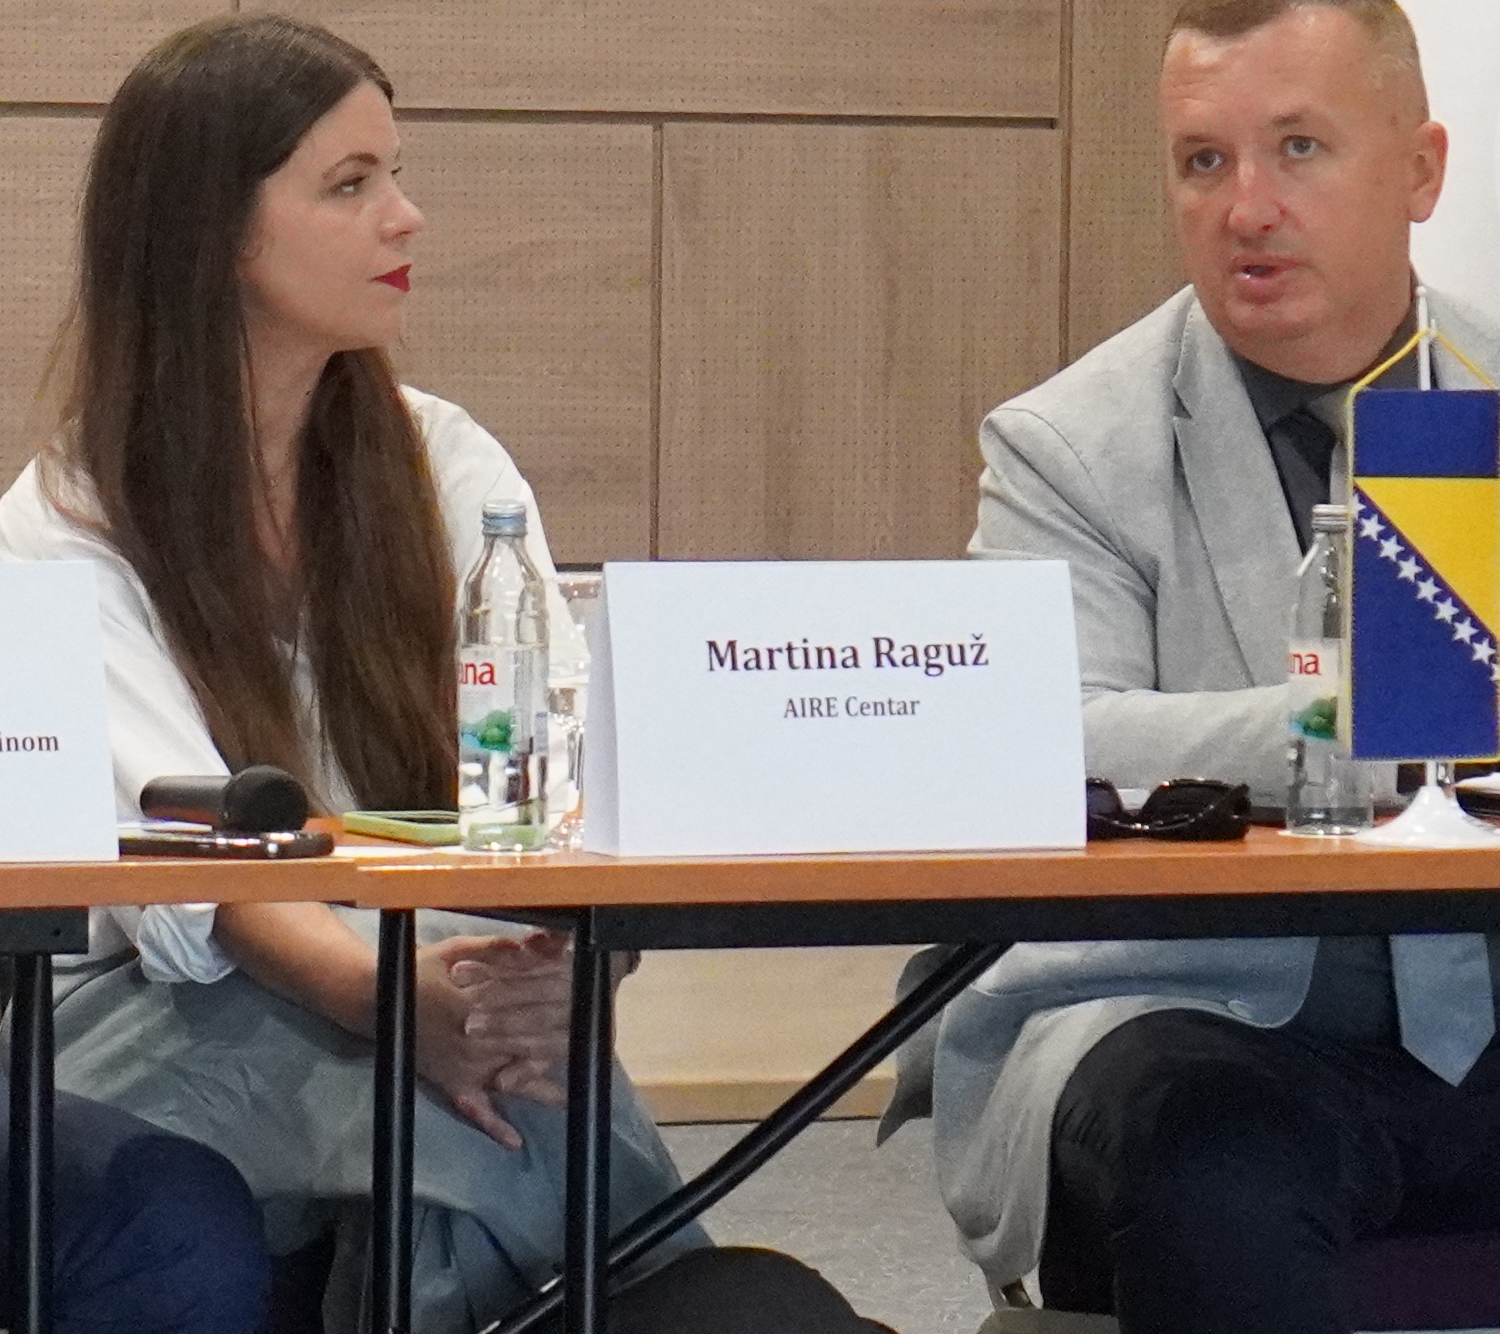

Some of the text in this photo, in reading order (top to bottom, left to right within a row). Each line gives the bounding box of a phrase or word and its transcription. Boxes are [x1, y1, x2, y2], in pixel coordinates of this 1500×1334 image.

[706, 634, 989, 677] Martina Raguž
[460, 661, 497, 685] na
[783, 696, 921, 719] AIRE Centar
